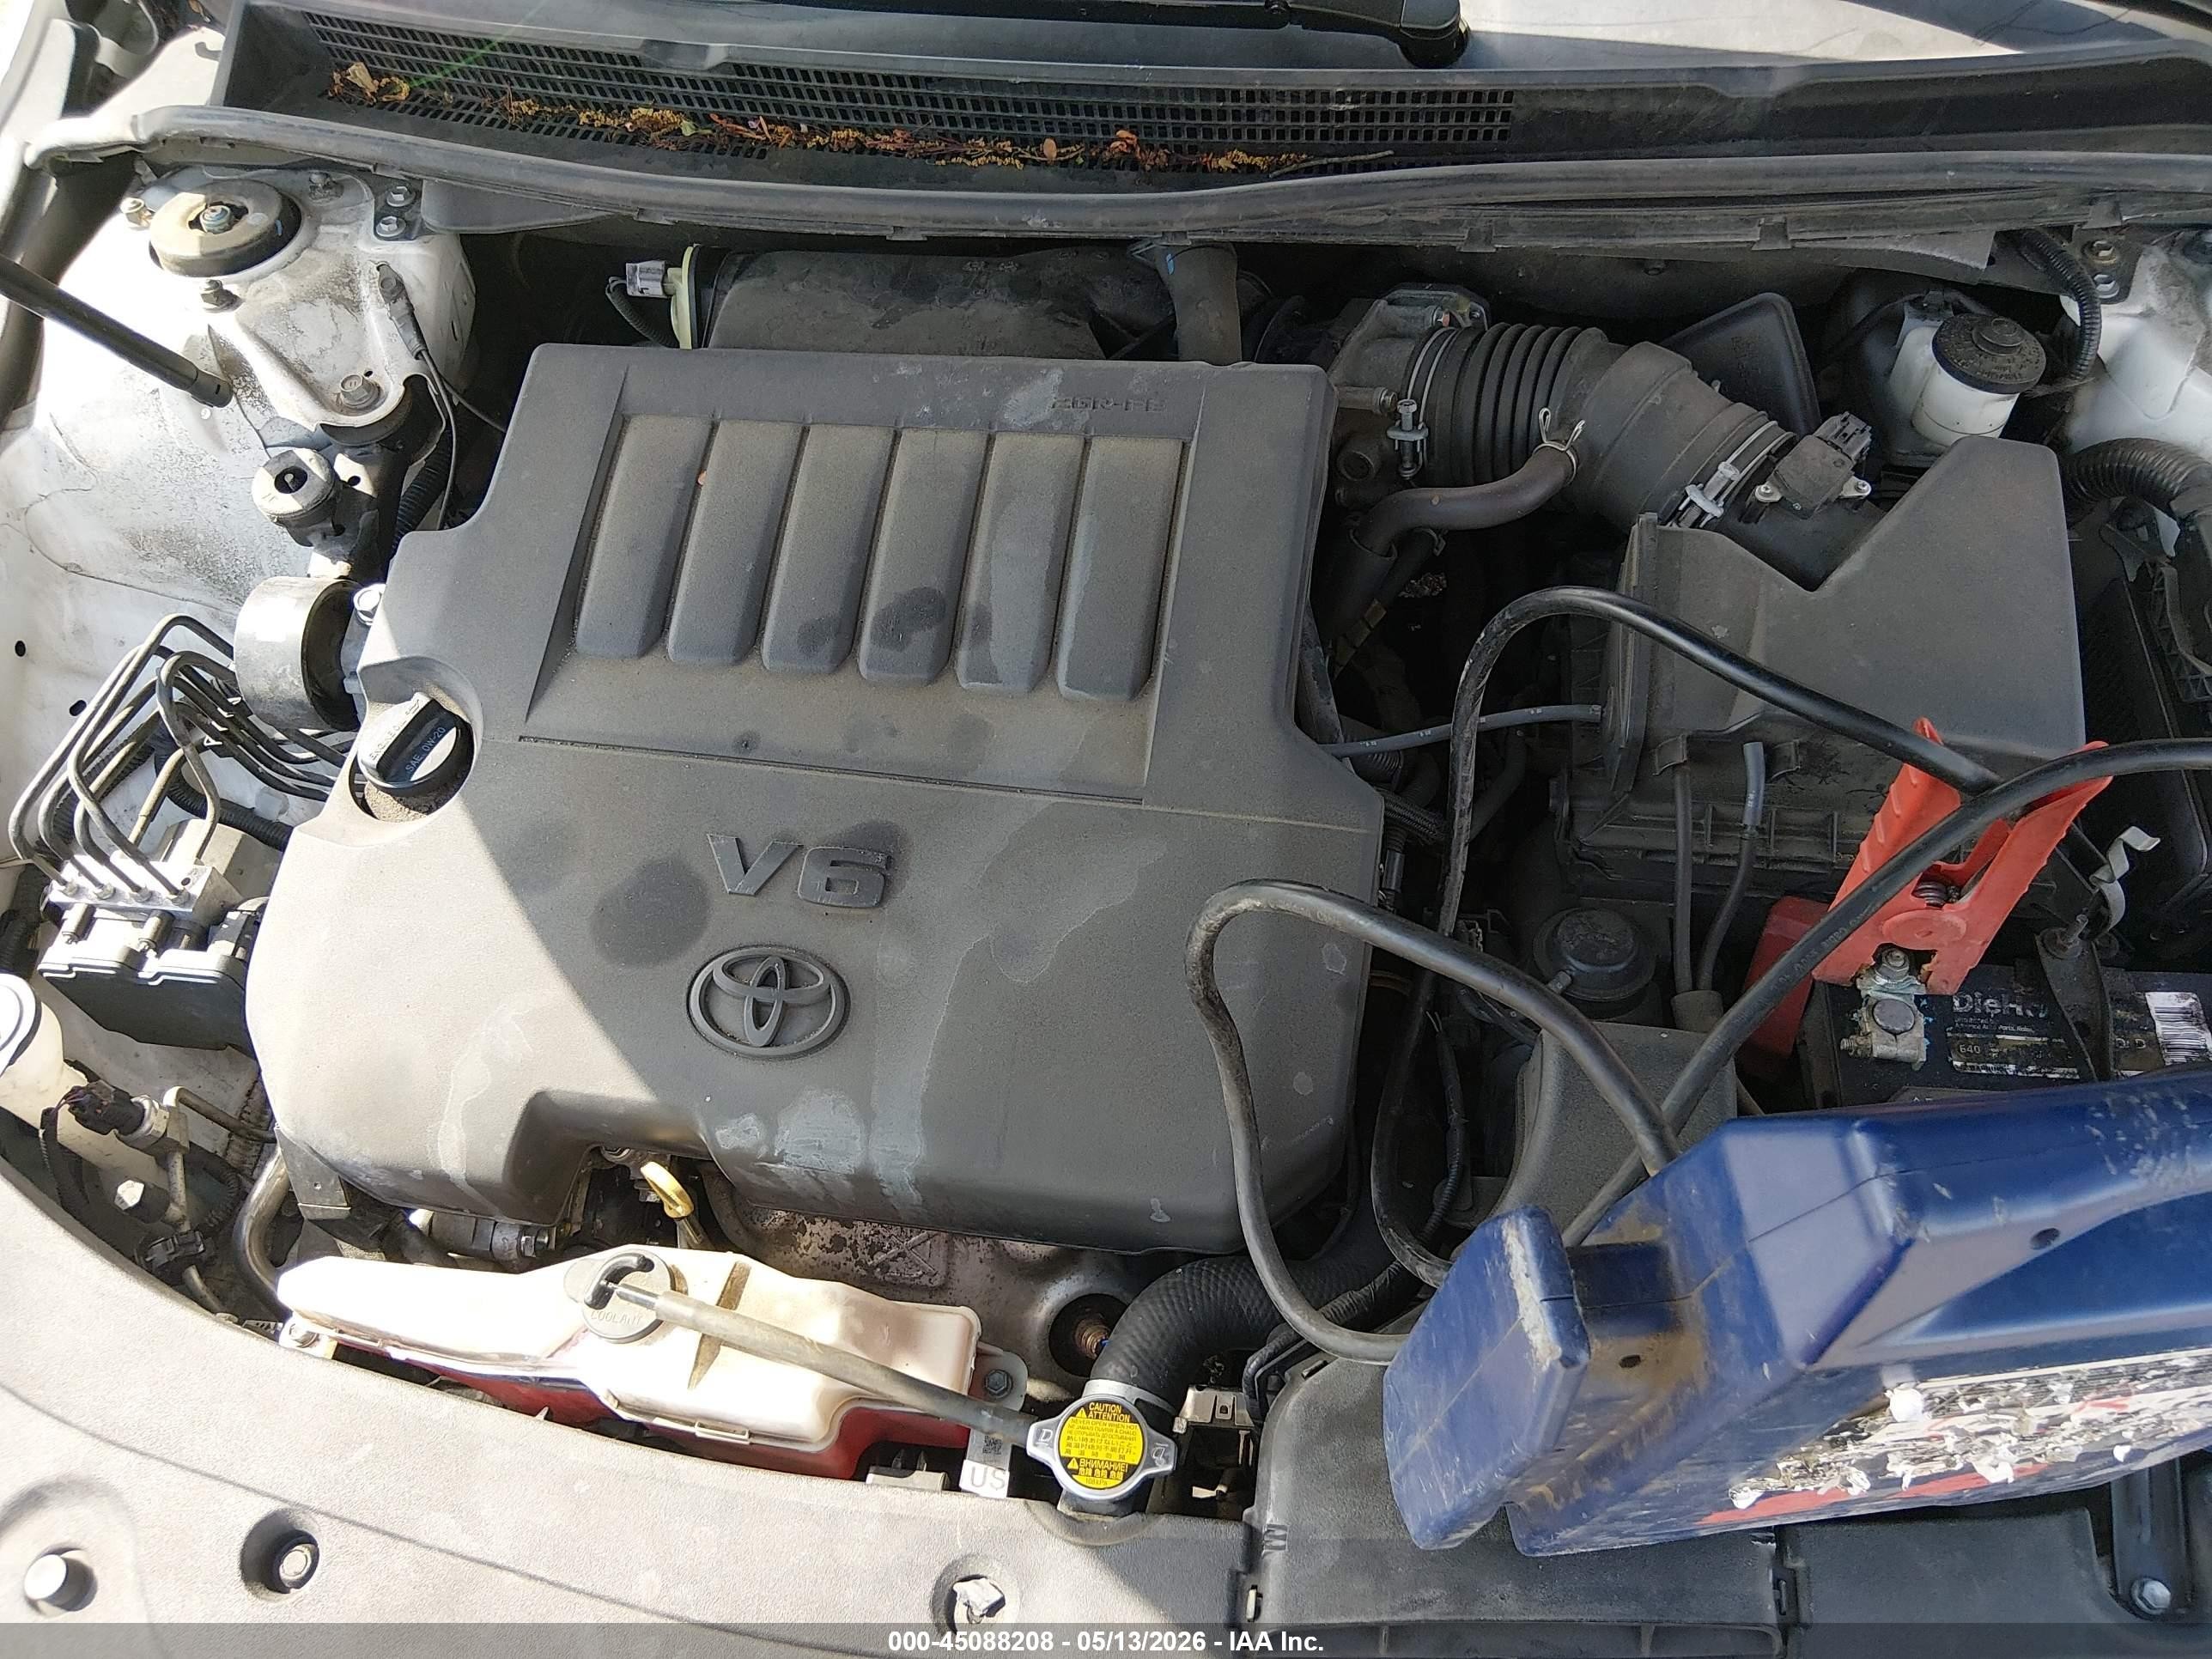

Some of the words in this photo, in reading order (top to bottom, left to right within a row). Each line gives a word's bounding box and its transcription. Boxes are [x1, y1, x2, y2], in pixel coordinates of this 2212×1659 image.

[404, 755, 422, 772] SAE
[422, 726, 447, 752] 0W-20
[706, 832, 893, 909] V6
[1959, 1044, 1981, 1054] 640
[591, 1310, 644, 1326] COOLANT
[1089, 1402, 1121, 1413] CAUTION
[1087, 1411, 1130, 1423] ATTENTION
[1079, 1458, 1128, 1473] ВНИМАНИЕ!
[970, 1466, 1006, 1490] US
